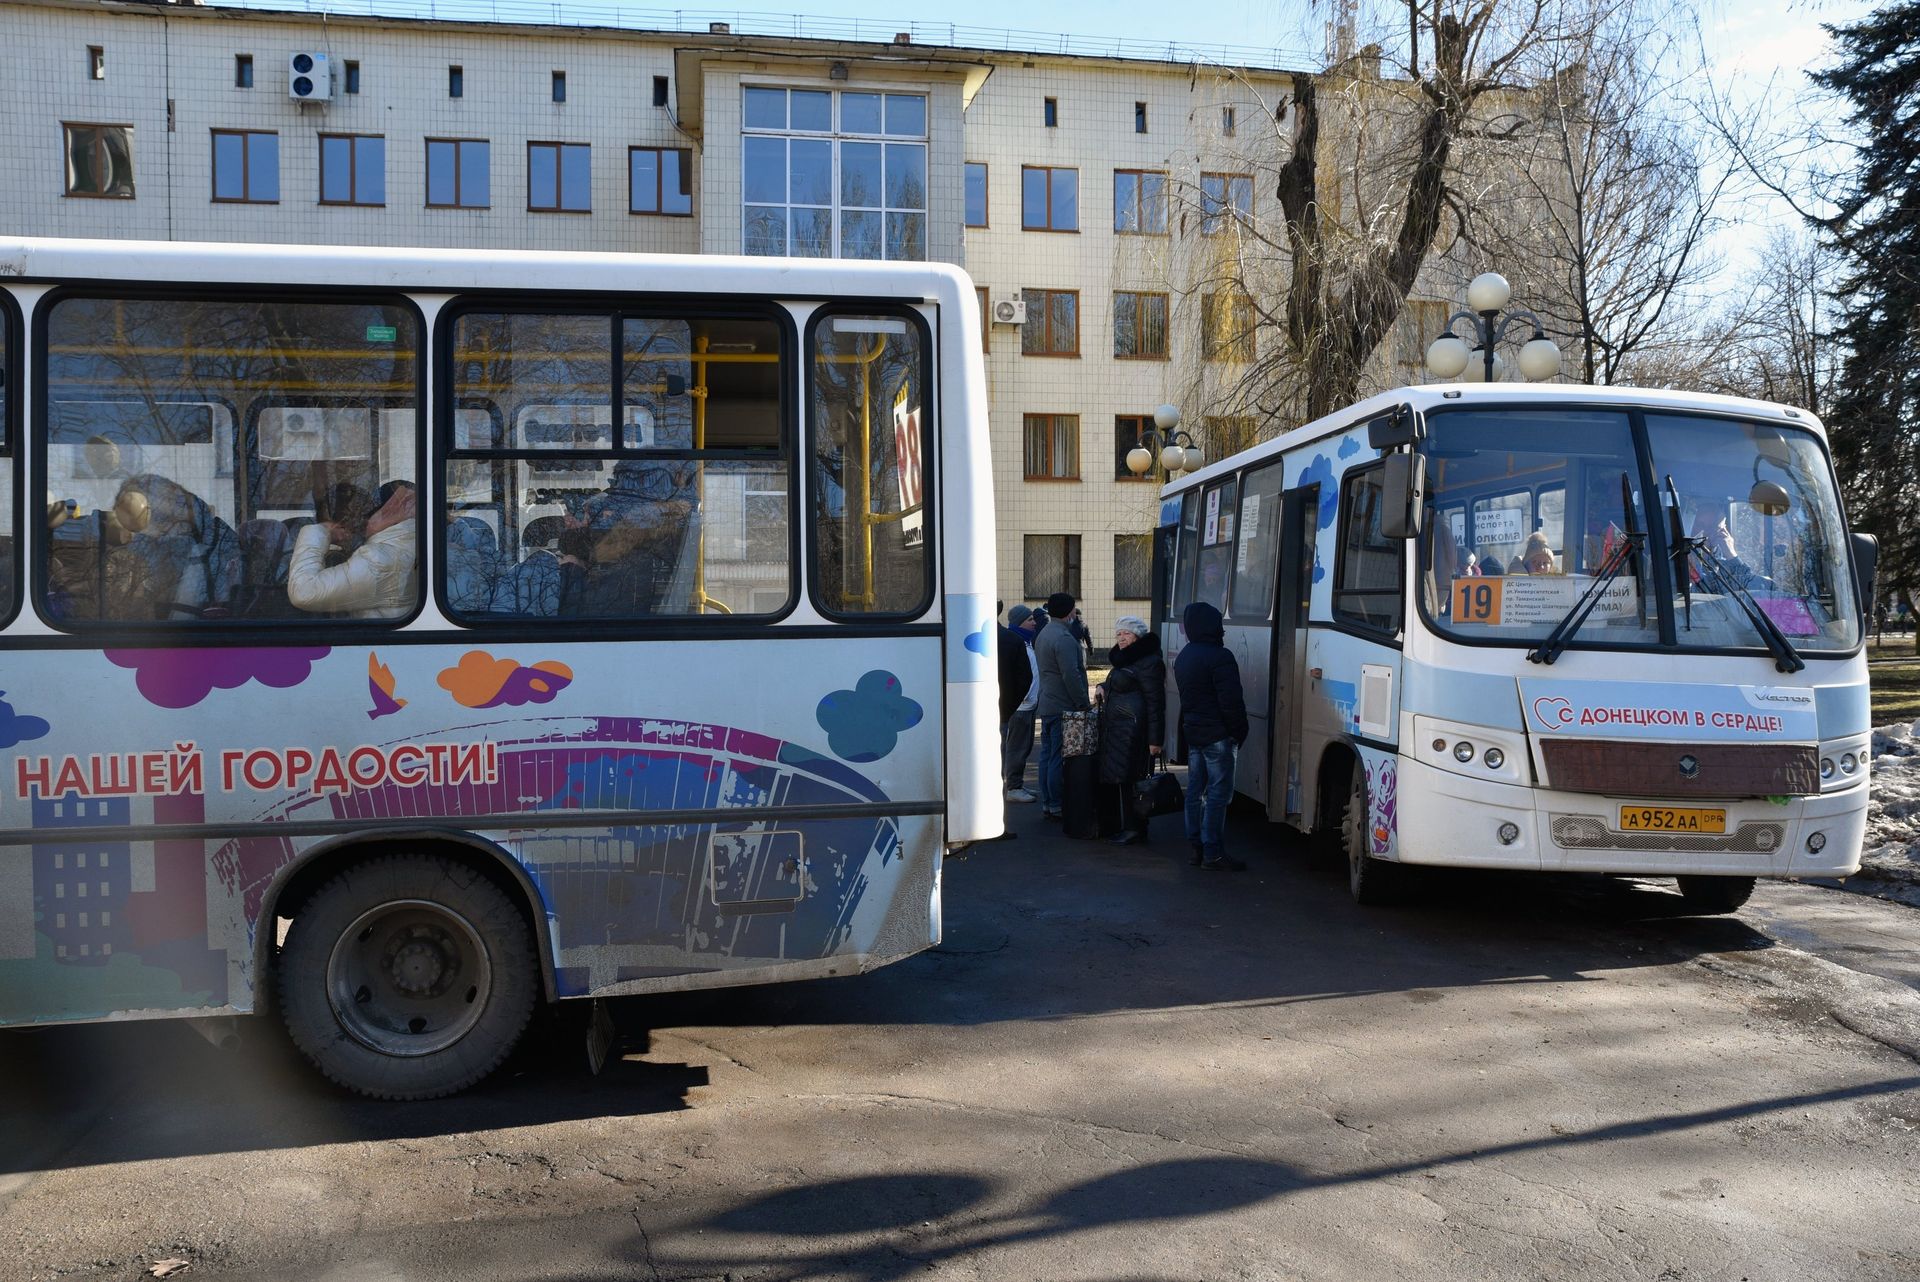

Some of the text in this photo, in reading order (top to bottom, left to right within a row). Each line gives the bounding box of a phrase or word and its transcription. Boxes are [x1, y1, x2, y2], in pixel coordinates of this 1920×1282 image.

[1460, 584, 1492, 619] 19
[1754, 692, 1812, 703] VECTOR
[1557, 706, 1783, 733] С ДОНЕЦКОМ В СЕРДЦЕ!
[17, 743, 496, 798] НАШЕЙ ГОРДОСТИ!
